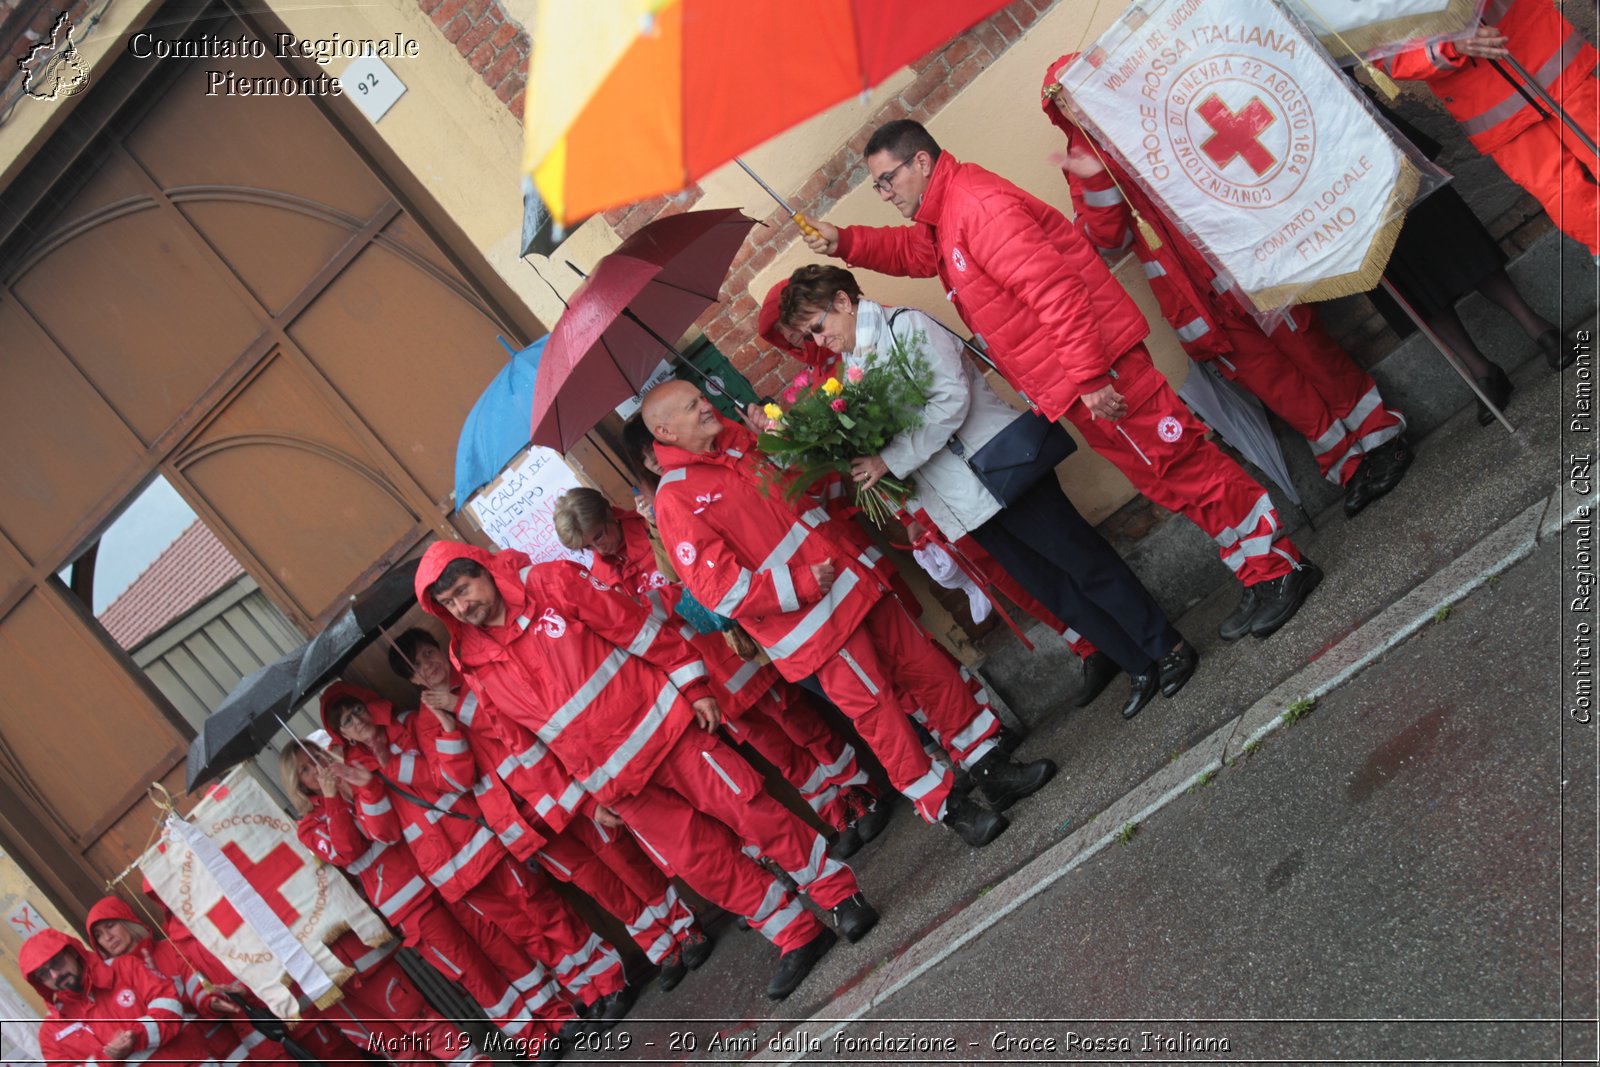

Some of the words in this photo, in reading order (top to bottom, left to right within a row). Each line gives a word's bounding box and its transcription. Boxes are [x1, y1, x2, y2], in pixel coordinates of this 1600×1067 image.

[1103, 46, 1149, 92] VOLONTARI
[1146, 29, 1169, 52] DEL
[1166, 0, 1206, 31] SOCCOR
[1141, 38, 1192, 101] ROSSA
[1191, 24, 1297, 60] ITALIANA
[1242, 61, 1262, 79] 22
[357, 72, 379, 95] 92
[1172, 58, 1233, 106] GINEVRA
[1264, 72, 1309, 135] AGOSTO
[1140, 104, 1170, 181] CROCE
[1170, 110, 1184, 127] DI
[1174, 136, 1272, 203] CONVENZIONE
[1288, 135, 1310, 176] 1864
[1253, 207, 1317, 262] COMITATO
[1314, 155, 1373, 212] LOCALE
[1296, 206, 1357, 262] FIANO
[478, 500, 496, 522] A
[491, 473, 529, 511] CAUSA
[528, 455, 551, 476] DEL
[485, 486, 544, 534] MALTEMPO
[180, 850, 195, 922] VOLONTAR
[211, 813, 292, 834] SOCCORSO
[228, 947, 274, 964] LANZO
